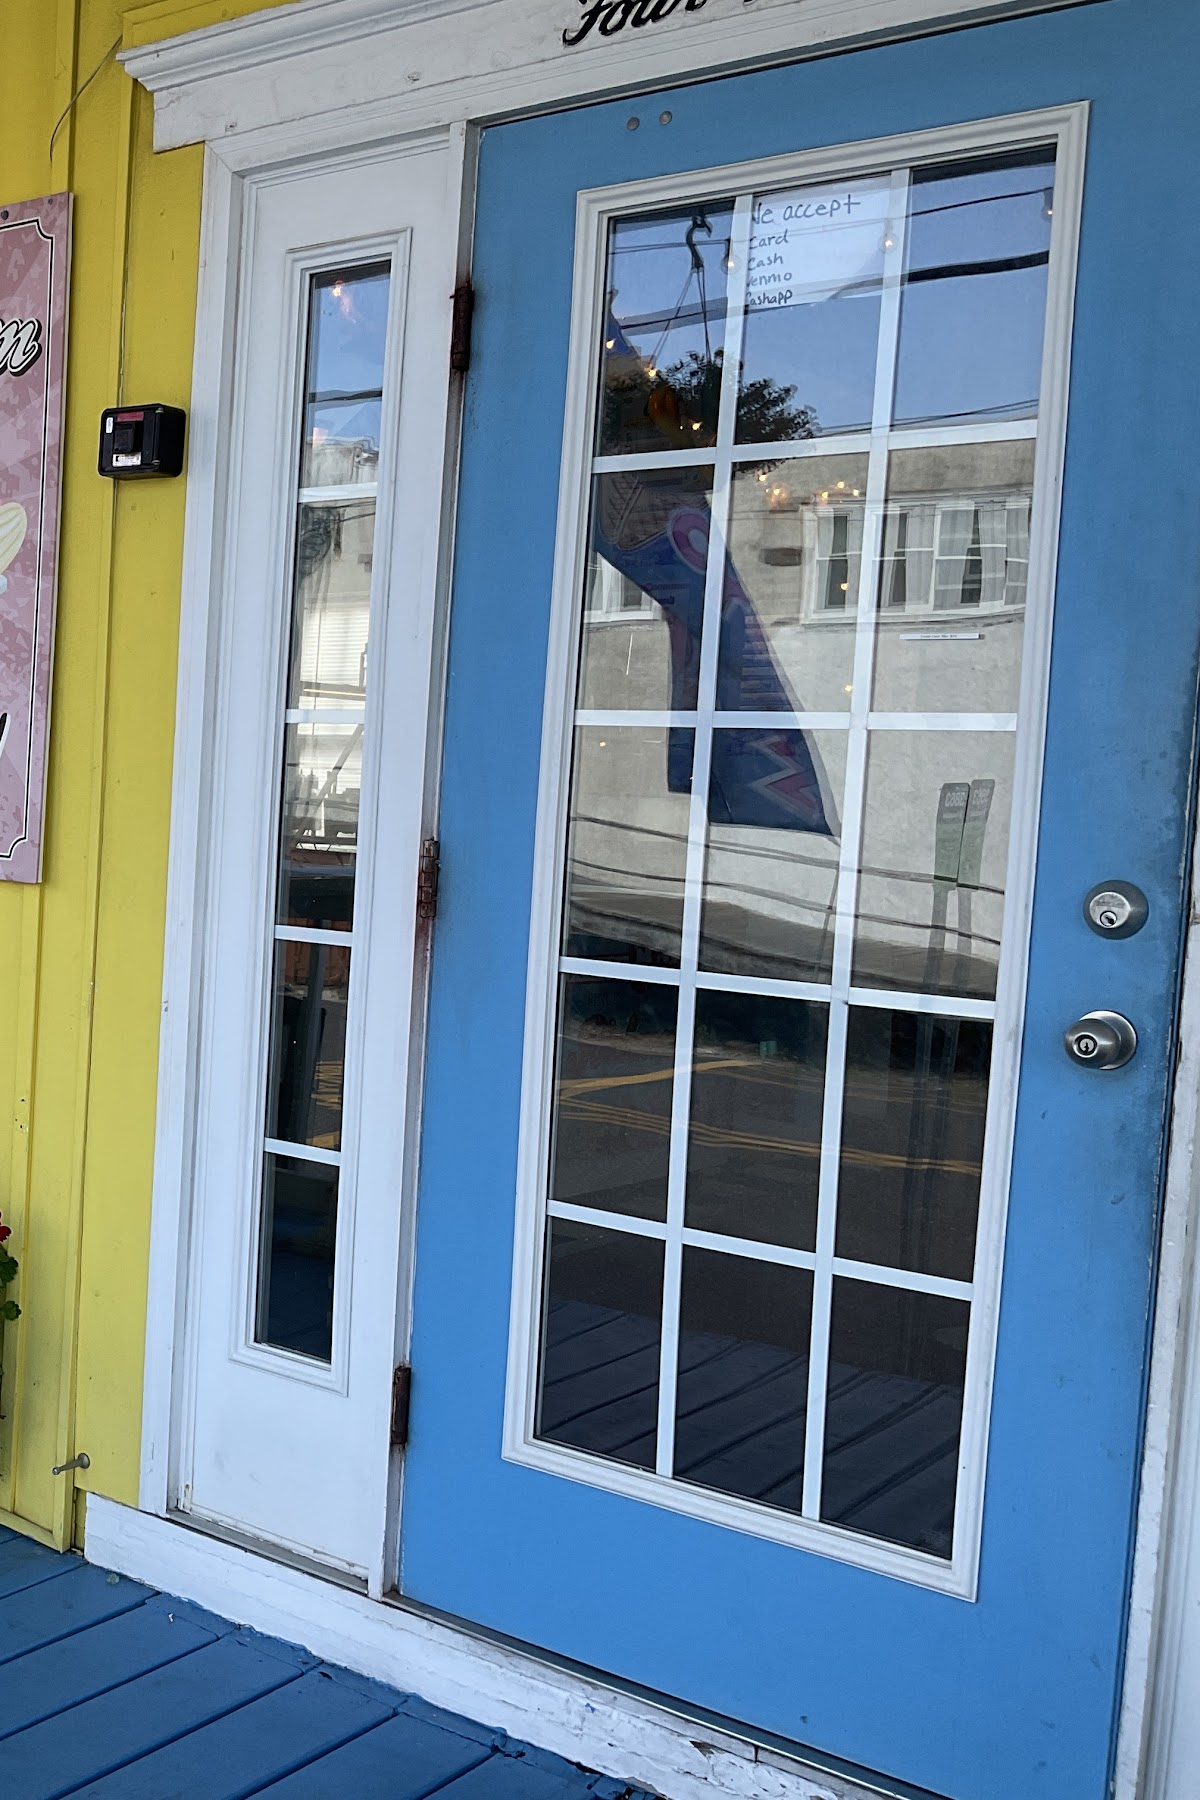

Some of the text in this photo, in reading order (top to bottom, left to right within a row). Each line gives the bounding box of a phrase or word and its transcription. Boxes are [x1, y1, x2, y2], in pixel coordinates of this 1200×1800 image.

[783, 193, 861, 221] accept
[749, 229, 789, 250] Card
[748, 253, 784, 271] Cash
